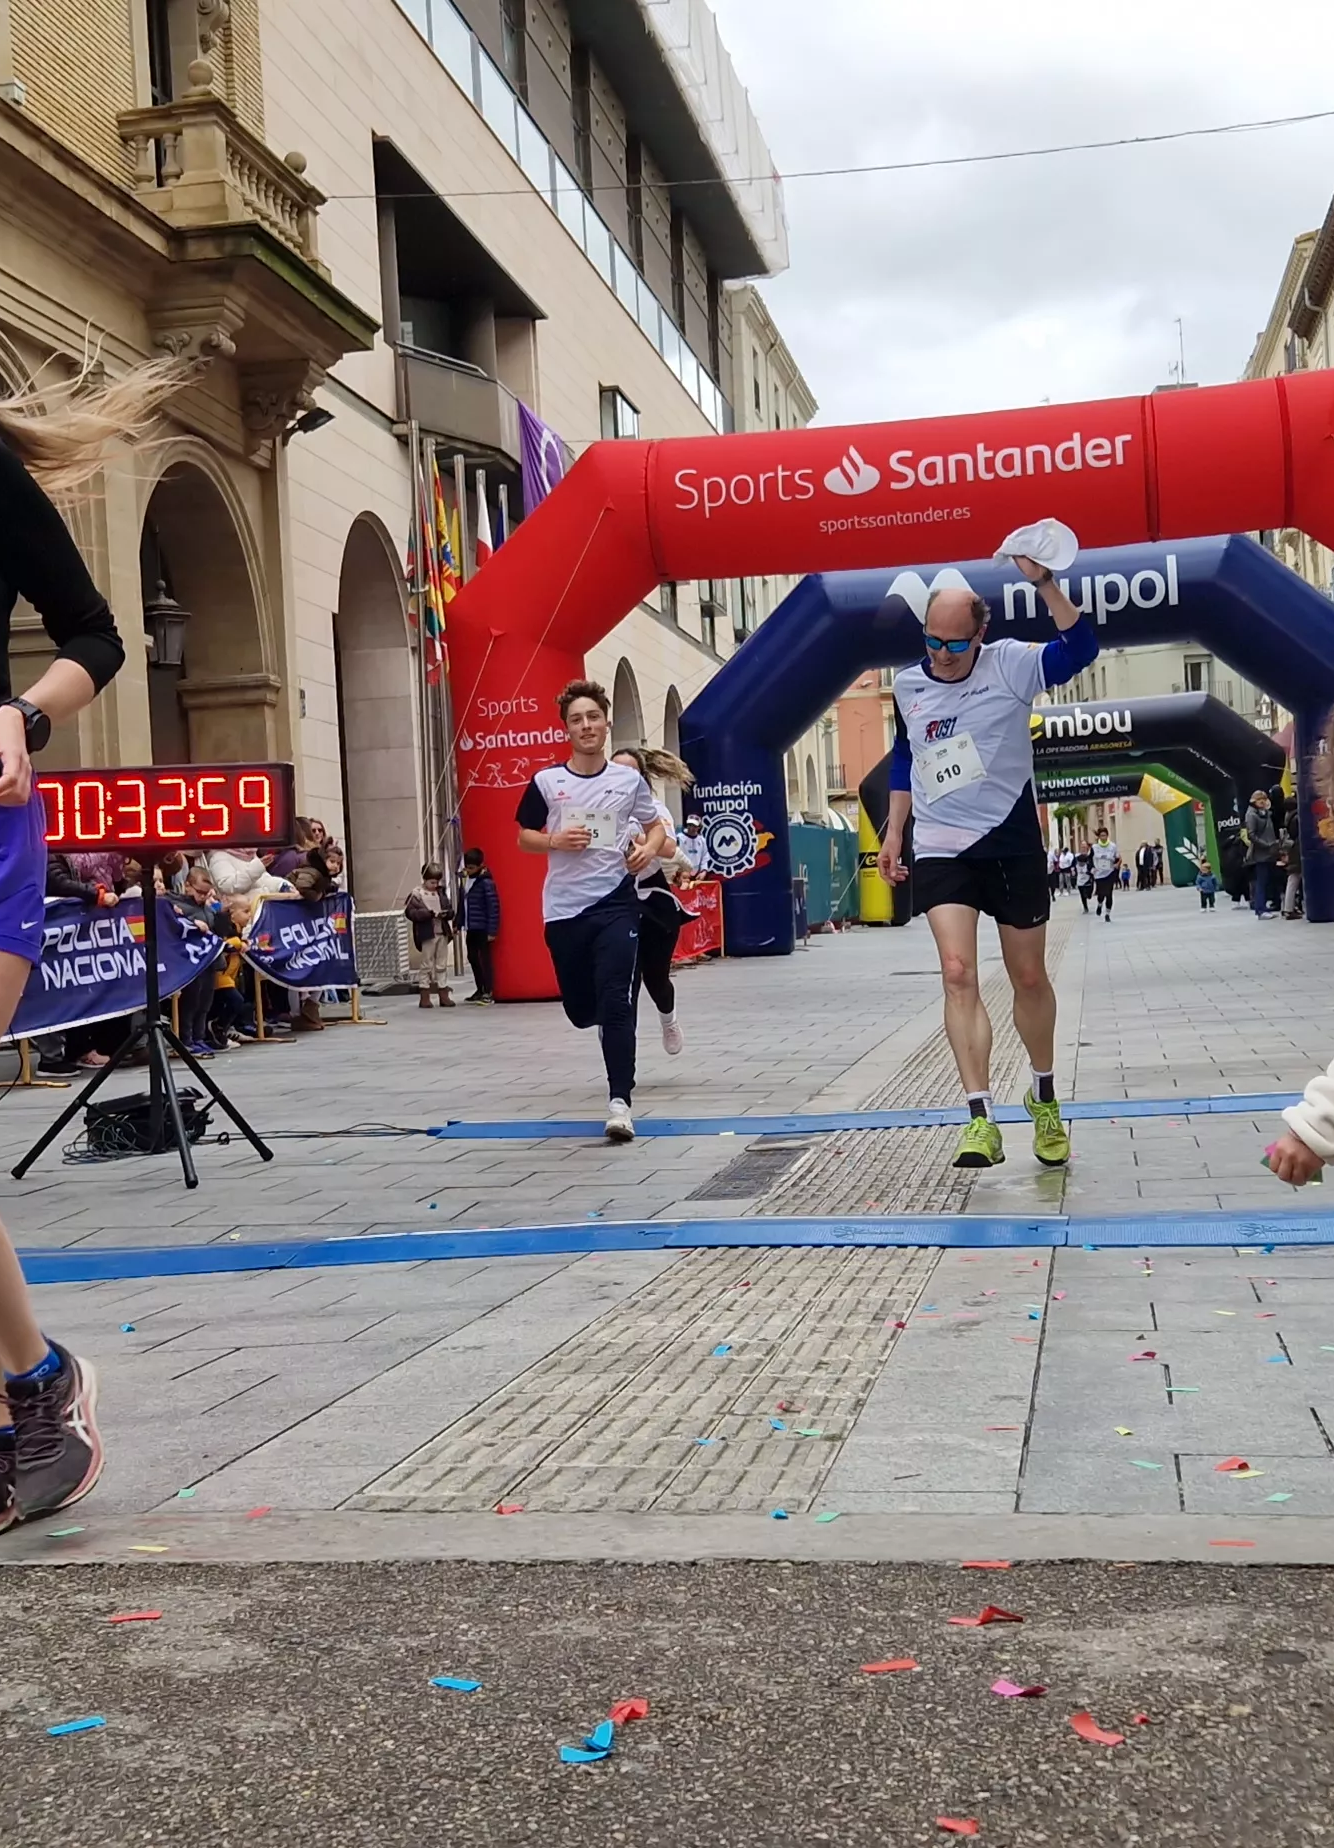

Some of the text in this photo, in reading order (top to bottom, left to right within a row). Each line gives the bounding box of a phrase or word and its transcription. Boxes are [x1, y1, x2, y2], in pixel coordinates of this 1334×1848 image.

[674, 431, 1133, 518] Sports Santander
[818, 505, 972, 535] sportssantander.es
[1003, 554, 1179, 626] mupol
[477, 696, 539, 721] Sports
[936, 764, 961, 784] 610
[692, 780, 763, 799] fundación
[1049, 789, 1077, 798] RURAL
[1079, 788, 1090, 796] DE
[37, 776, 273, 841] 00:32:59
[703, 795, 749, 813] mupol
[40, 947, 167, 991] NACIONA
